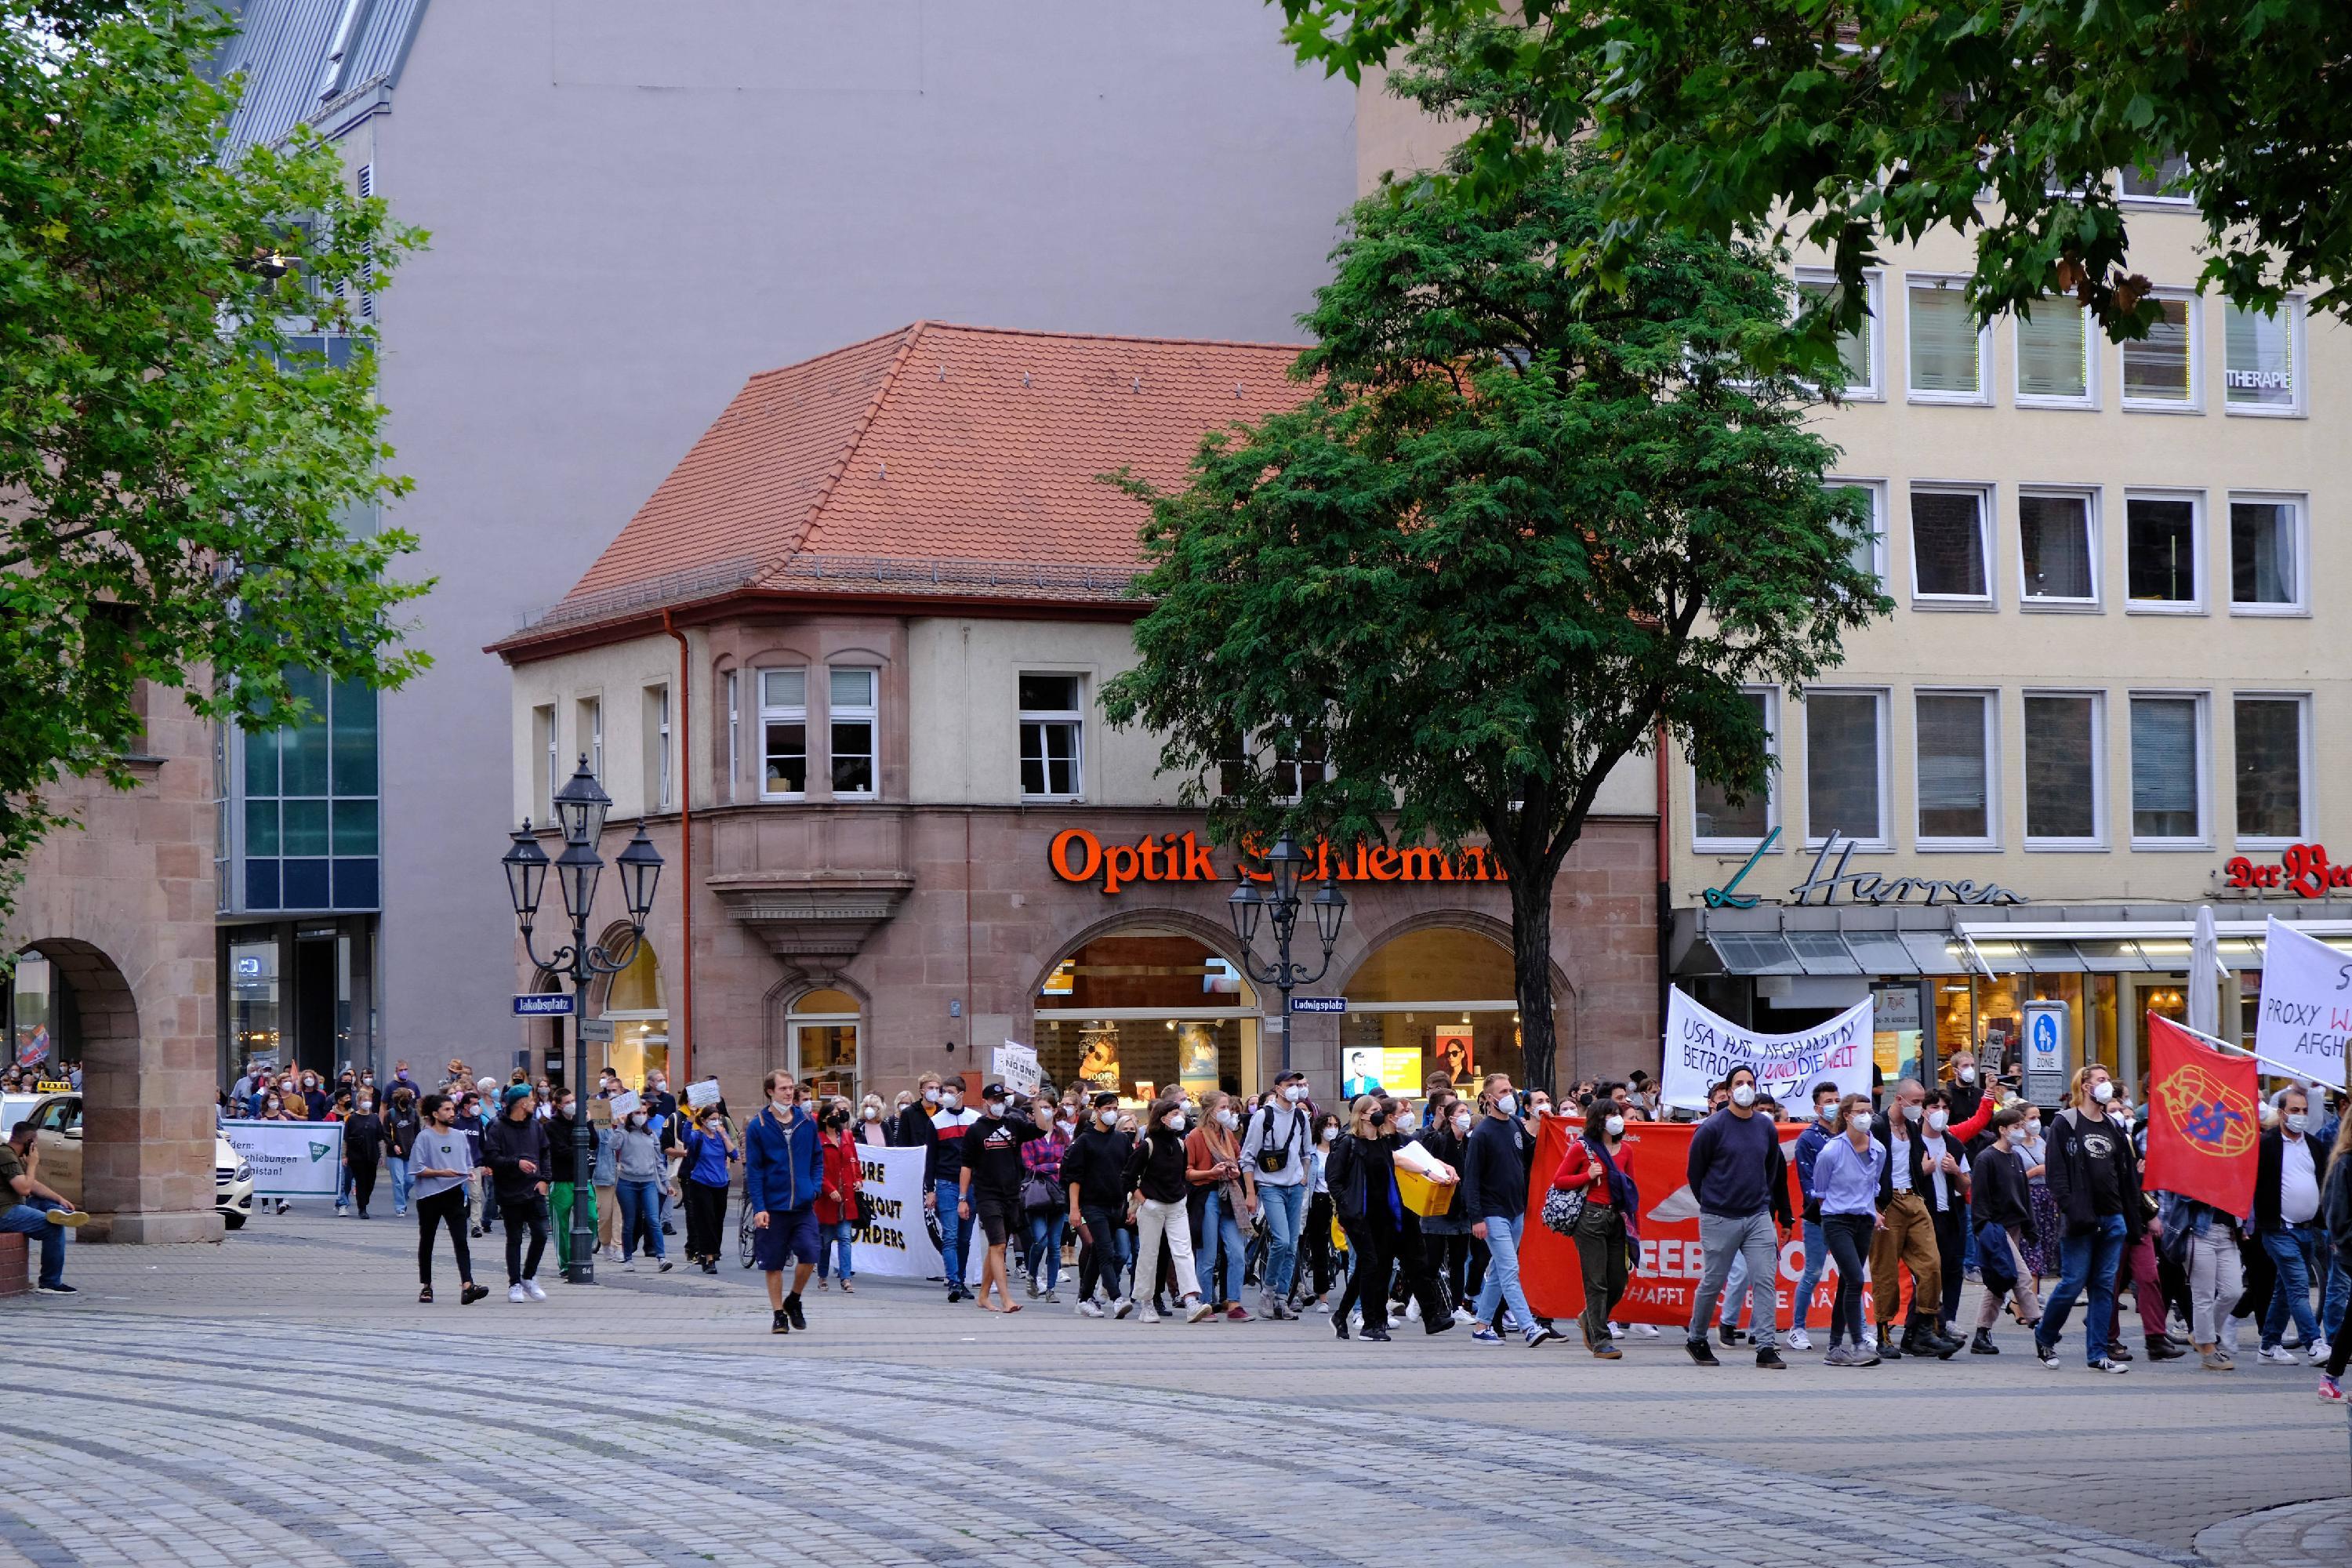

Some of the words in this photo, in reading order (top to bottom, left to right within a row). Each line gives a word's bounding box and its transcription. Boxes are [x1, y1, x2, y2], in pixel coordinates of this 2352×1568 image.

[1048, 829, 1219, 893] Optik
[2224, 856, 2281, 887] Der
[518, 998, 568, 1011] Jakobsplatz
[1294, 1000, 1343, 1011] Ludwigsplatz
[2266, 998, 2321, 1026] PROXY
[1684, 1018, 1715, 1047] USA
[1723, 1034, 1752, 1058] HAT
[1006, 1059, 1018, 1070] NO
[1765, 1061, 1797, 1079] UND
[1798, 1054, 1823, 1075] DIE
[2037, 1058, 2055, 1068] ZONE
[241, 1154, 297, 1164] chiebungen
[250, 1167, 282, 1176] nistan!
